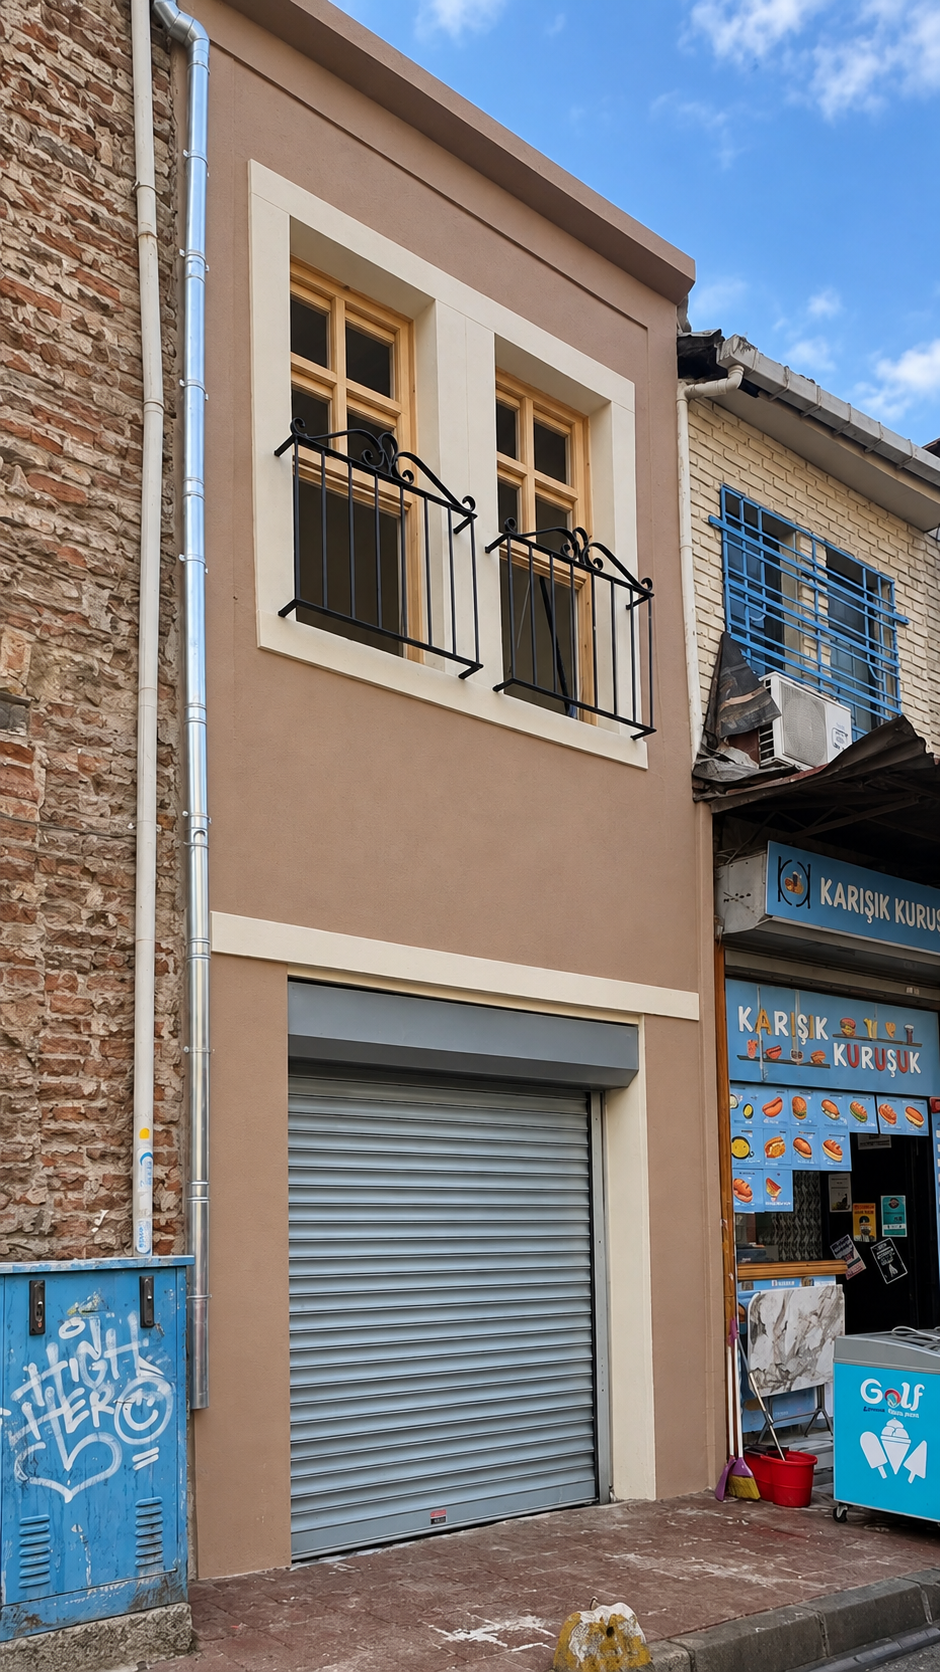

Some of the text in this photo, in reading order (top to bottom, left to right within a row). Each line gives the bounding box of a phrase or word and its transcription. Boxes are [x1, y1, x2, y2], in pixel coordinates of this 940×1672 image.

[820, 877, 891, 924] KARIŞIK
[738, 1005, 829, 1045] KARIŞIK
[833, 1042, 922, 1078] KURUŞUK
[860, 1378, 925, 1411] Golf
